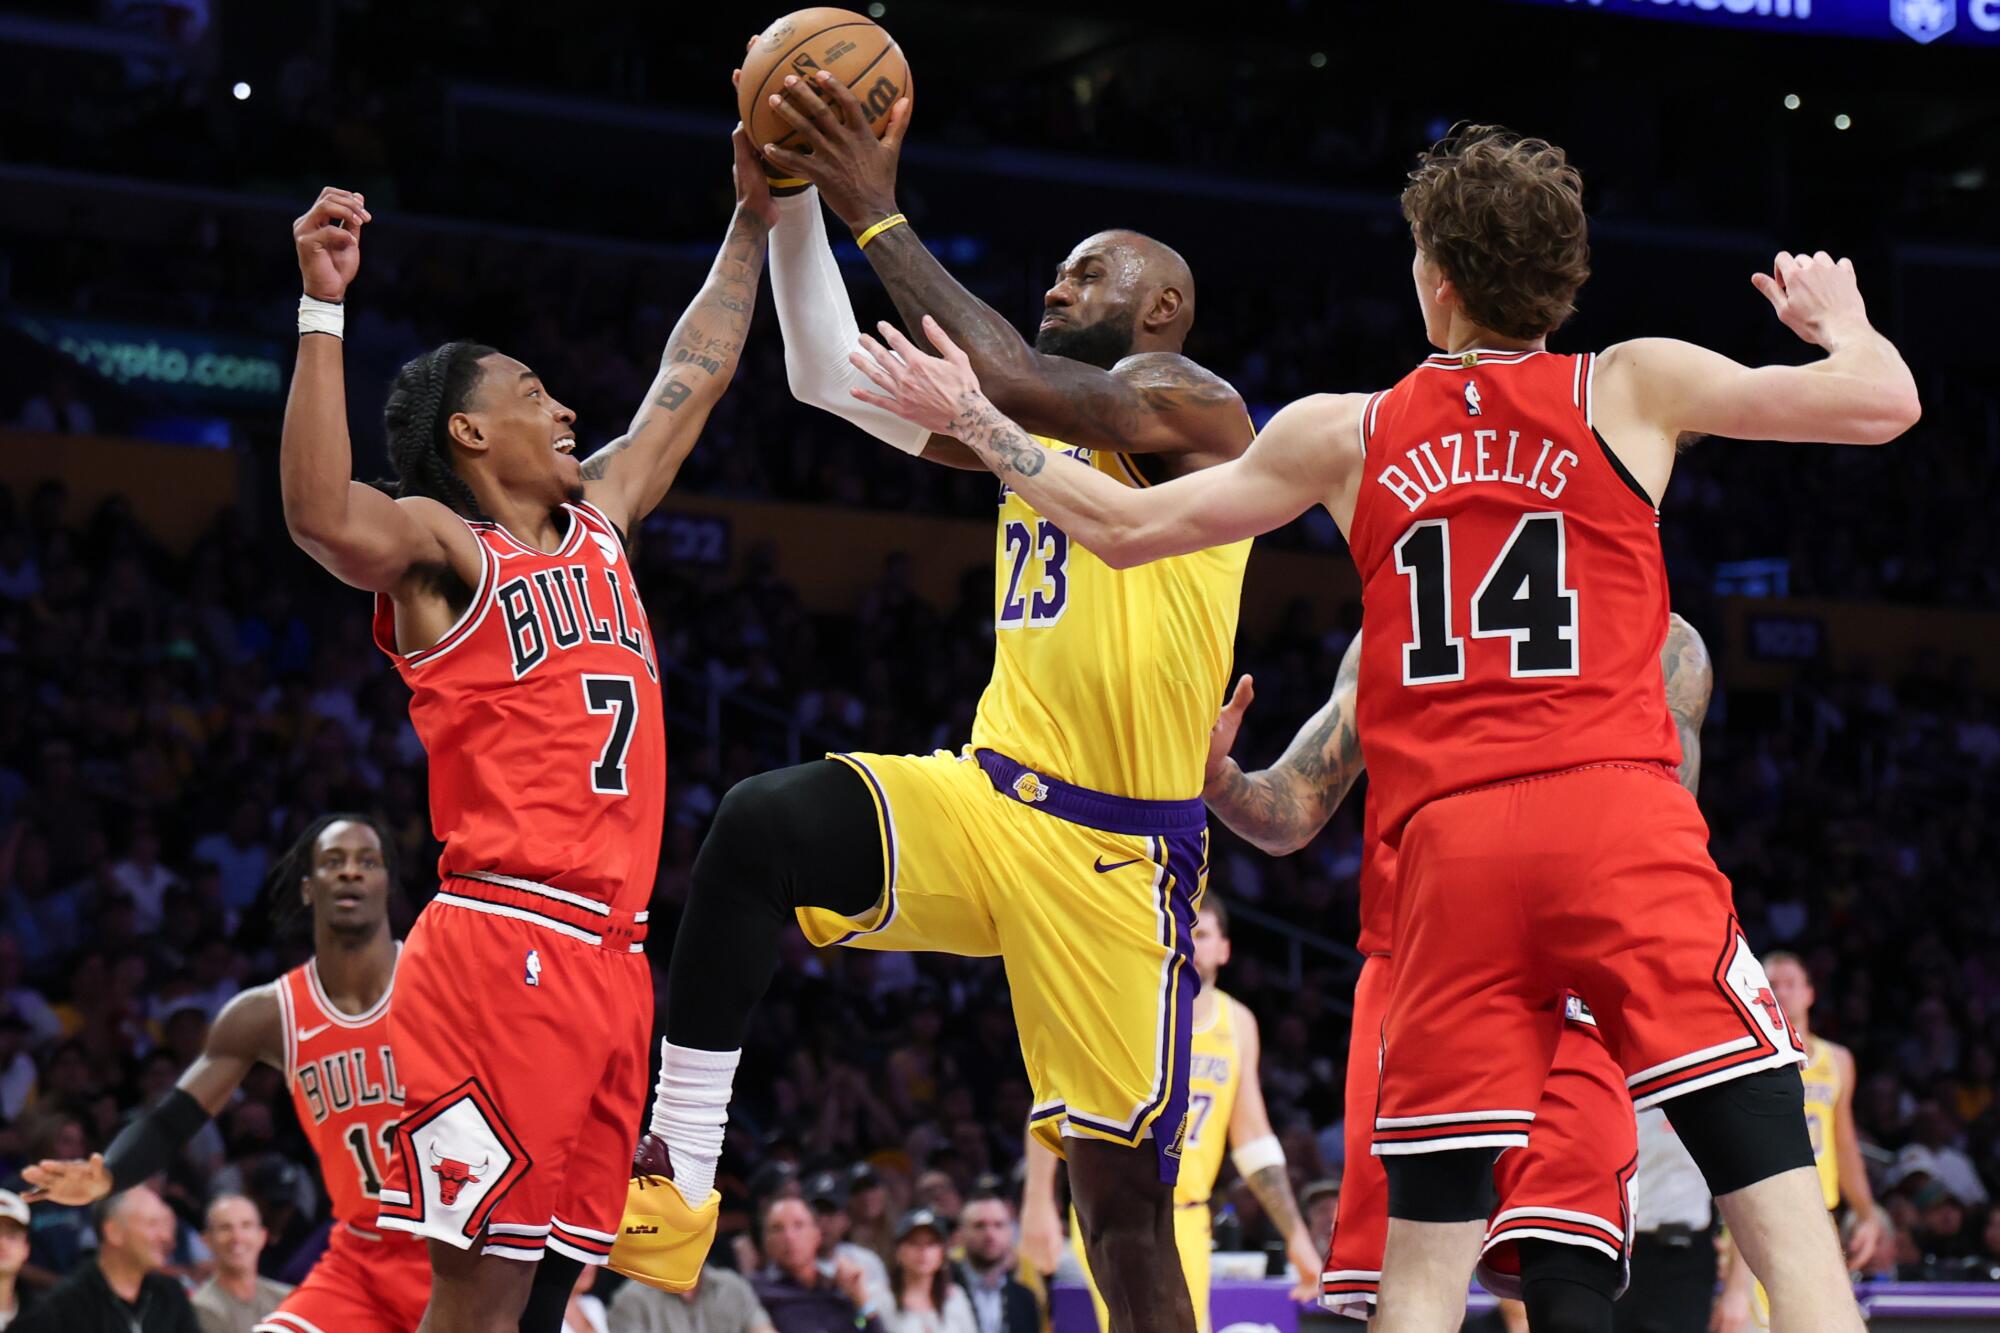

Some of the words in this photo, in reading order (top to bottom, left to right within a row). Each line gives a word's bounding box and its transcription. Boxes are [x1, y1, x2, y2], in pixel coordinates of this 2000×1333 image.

[1377, 429, 1579, 512] BUZELIS
[995, 517, 1069, 630] 23
[1393, 511, 1580, 687] 14
[581, 673, 640, 796] 7
[297, 1045, 406, 1126] BULL
